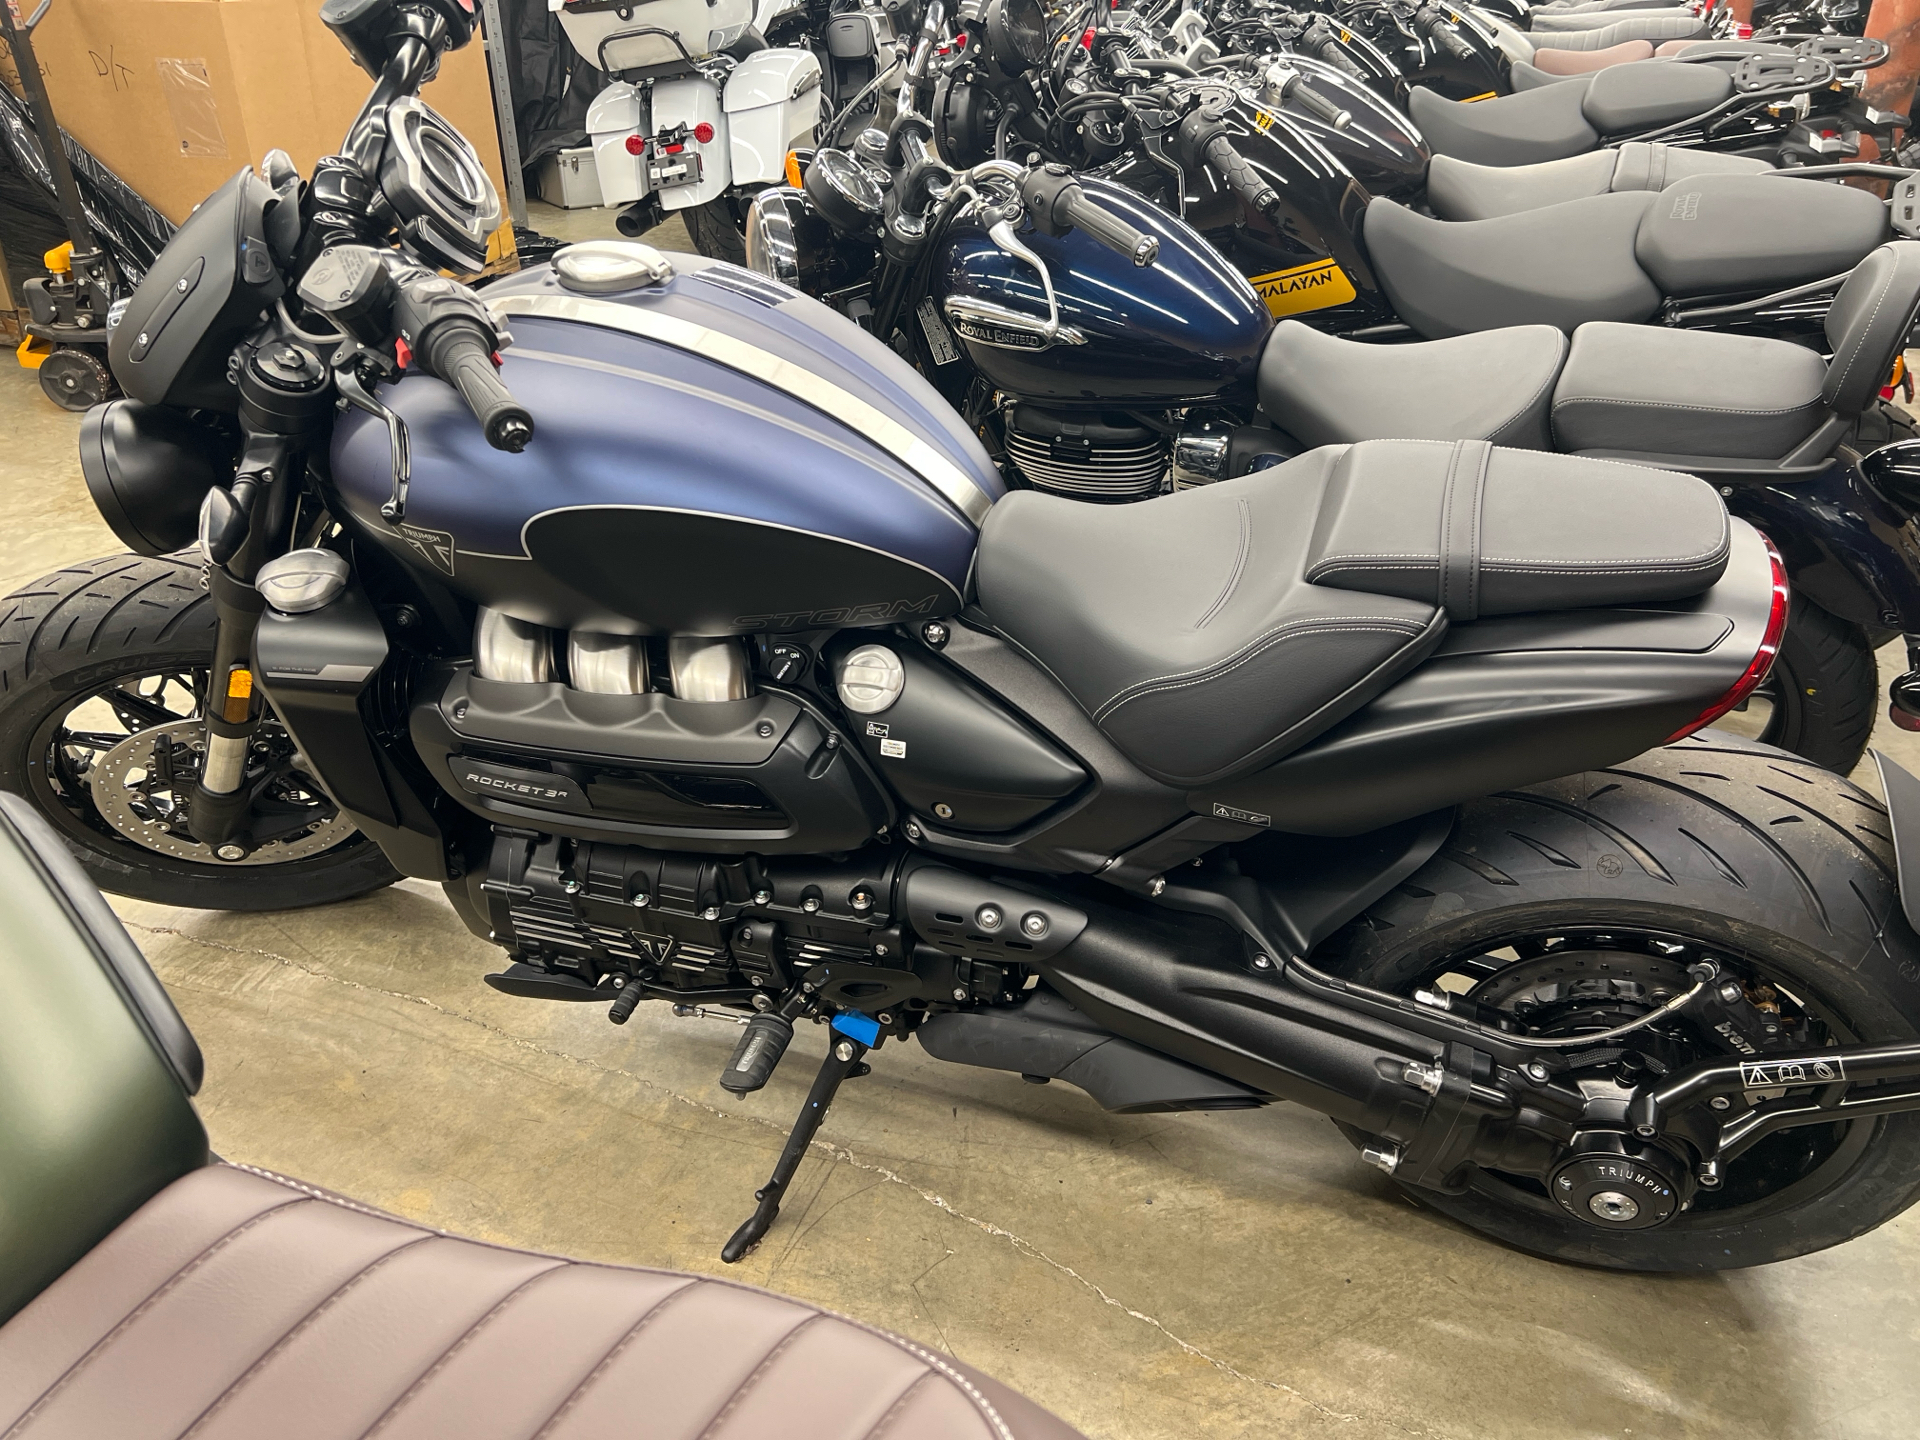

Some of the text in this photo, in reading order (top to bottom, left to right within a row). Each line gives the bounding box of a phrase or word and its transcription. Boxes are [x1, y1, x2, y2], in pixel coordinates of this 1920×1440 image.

[88, 44, 135, 92] D/T
[960, 321, 1039, 347] ROYAL ENFIELD
[402, 527, 442, 543] TRIUMPH
[728, 594, 939, 630] STORM
[466, 773, 545, 795] ROCKET
[1598, 1166, 1662, 1194] TRIUMPH
